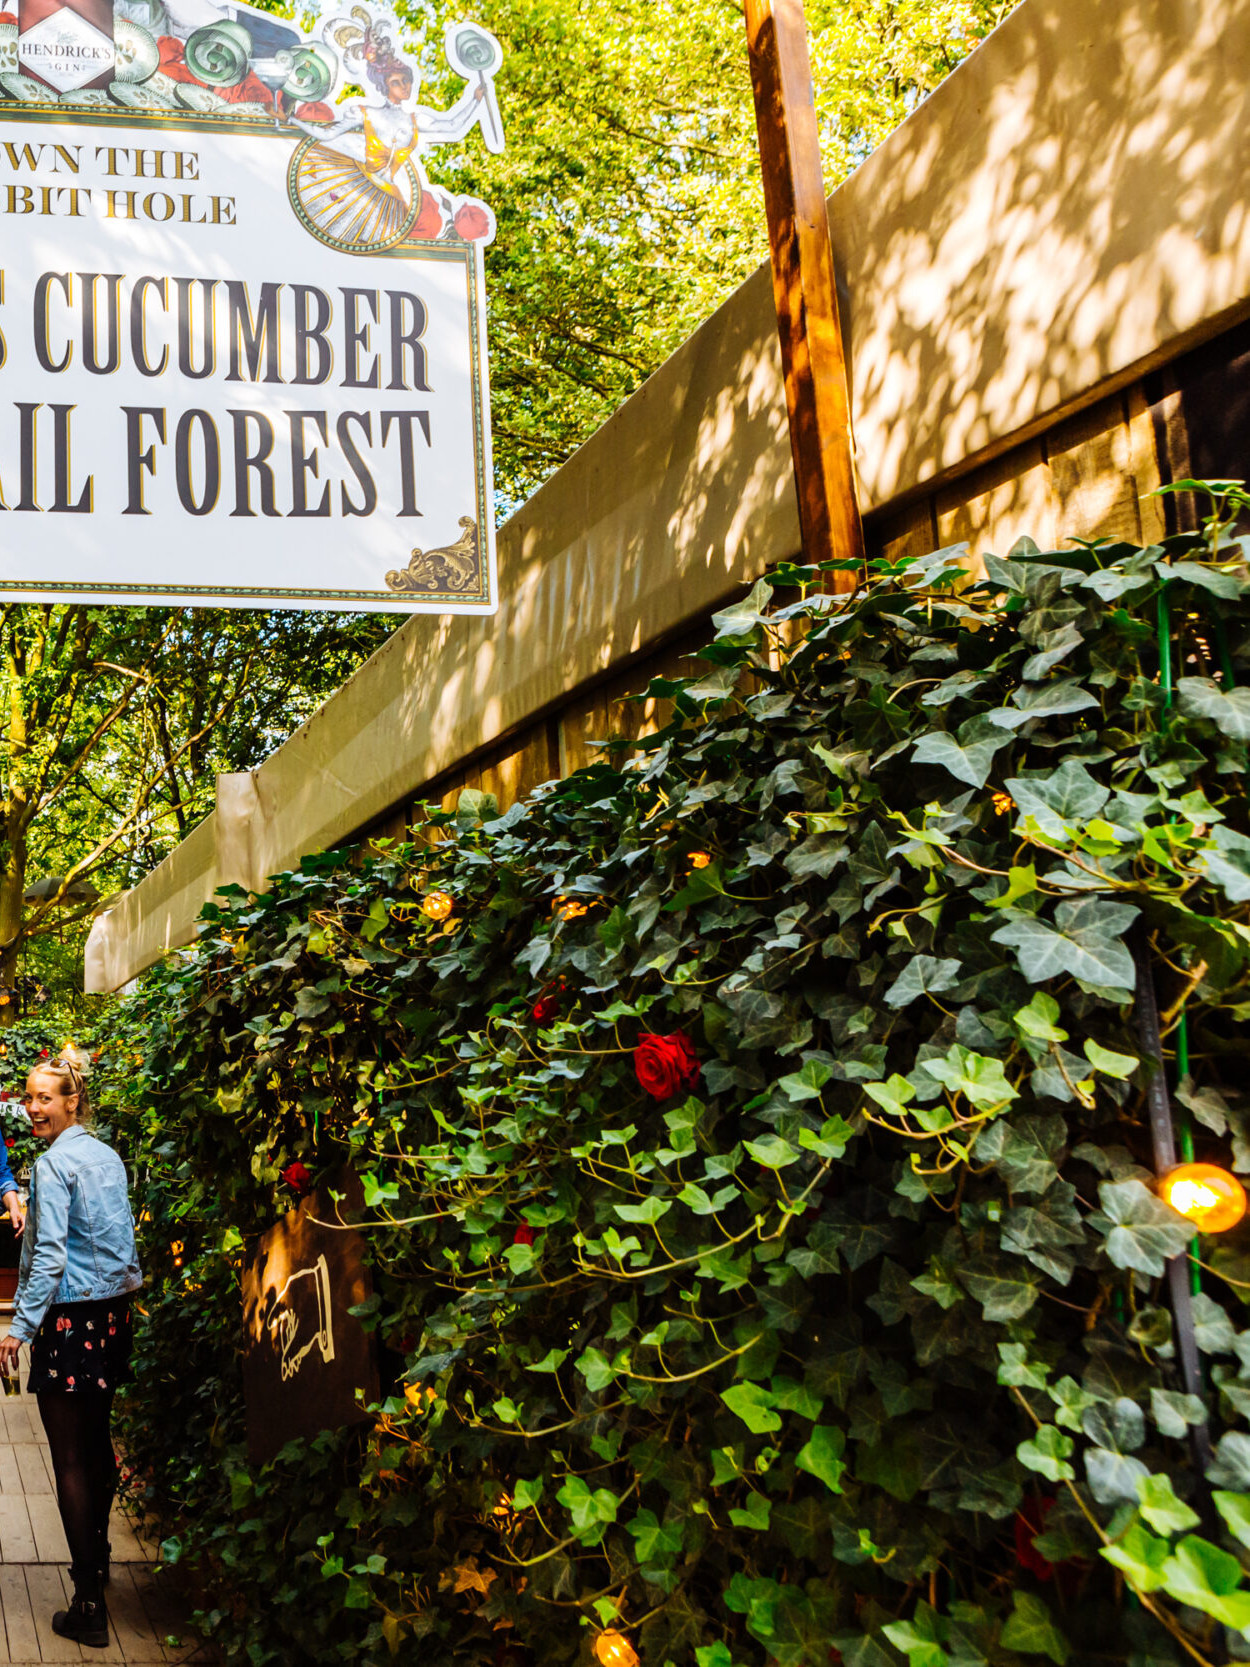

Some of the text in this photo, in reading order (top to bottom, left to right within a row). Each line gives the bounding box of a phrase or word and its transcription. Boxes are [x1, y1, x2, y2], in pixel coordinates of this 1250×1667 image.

[22, 43, 111, 59] HENDRICK'S
[54, 62, 81, 72] GIN
[95, 146, 200, 181] THE
[102, 189, 237, 225] HOLE
[33, 271, 436, 393] CUCUMBER
[120, 406, 432, 518] FOREST
